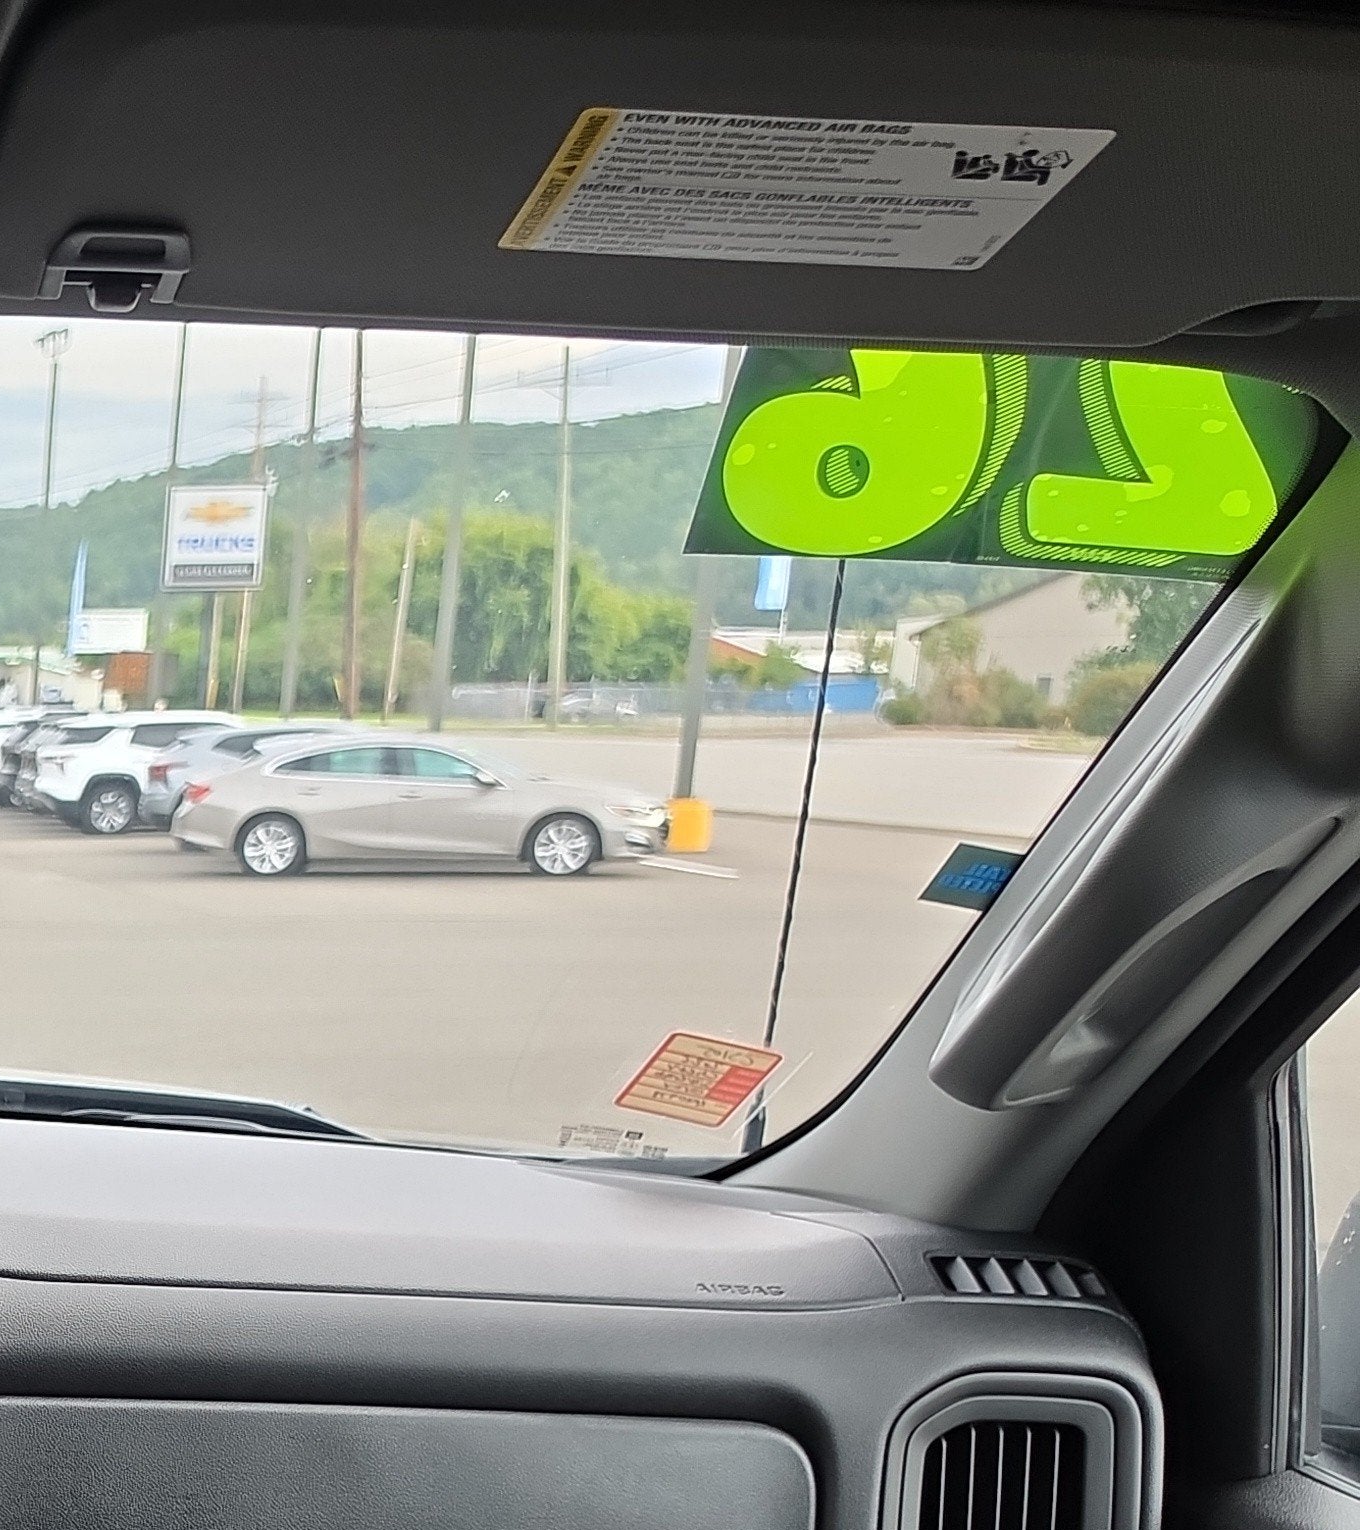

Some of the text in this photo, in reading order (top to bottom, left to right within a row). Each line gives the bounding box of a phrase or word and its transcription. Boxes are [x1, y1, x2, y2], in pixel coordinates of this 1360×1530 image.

[623, 113, 913, 135] EVEN WITH ADVANCED AIR BAGS
[628, 186, 671, 196] AVEC
[673, 188, 706, 198] DES
[708, 190, 752, 201] SACS
